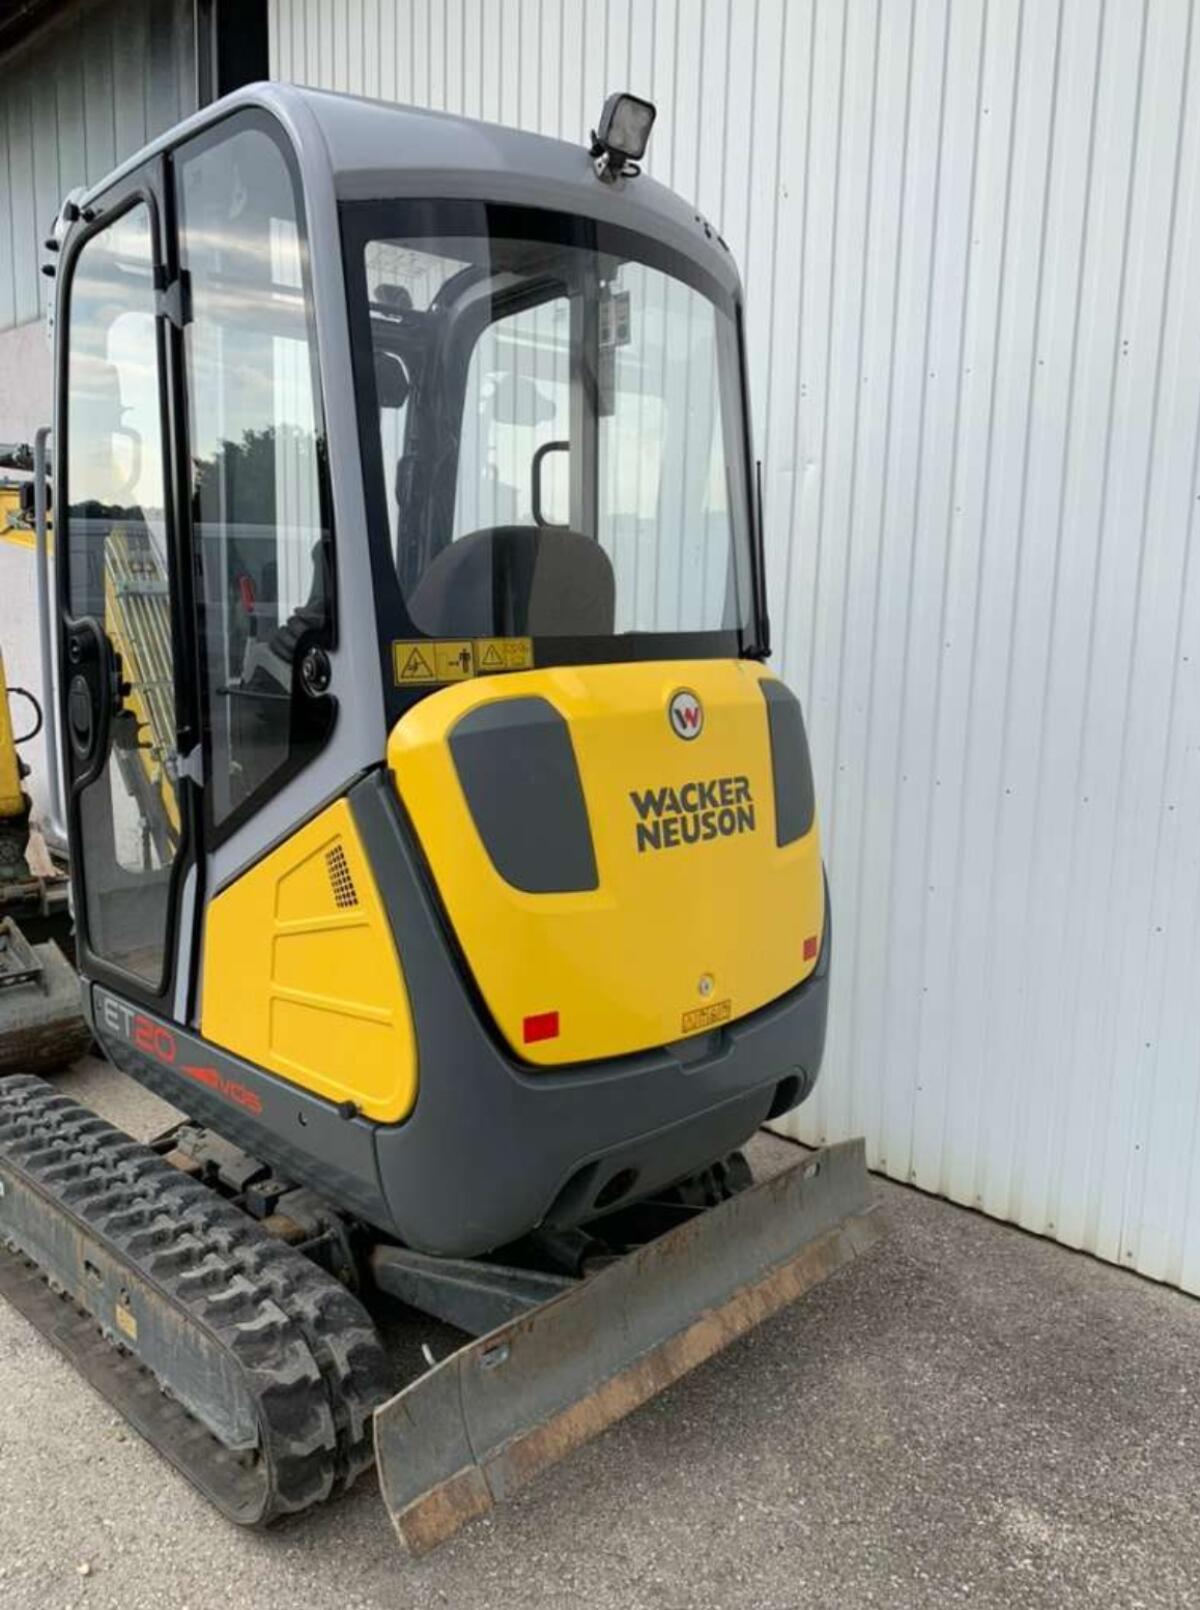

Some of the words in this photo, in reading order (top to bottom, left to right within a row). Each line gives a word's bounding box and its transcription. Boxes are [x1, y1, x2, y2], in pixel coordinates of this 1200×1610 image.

[629, 776, 753, 820] WACKER
[636, 804, 756, 852] NEUSON
[104, 998, 177, 1064] ET20
